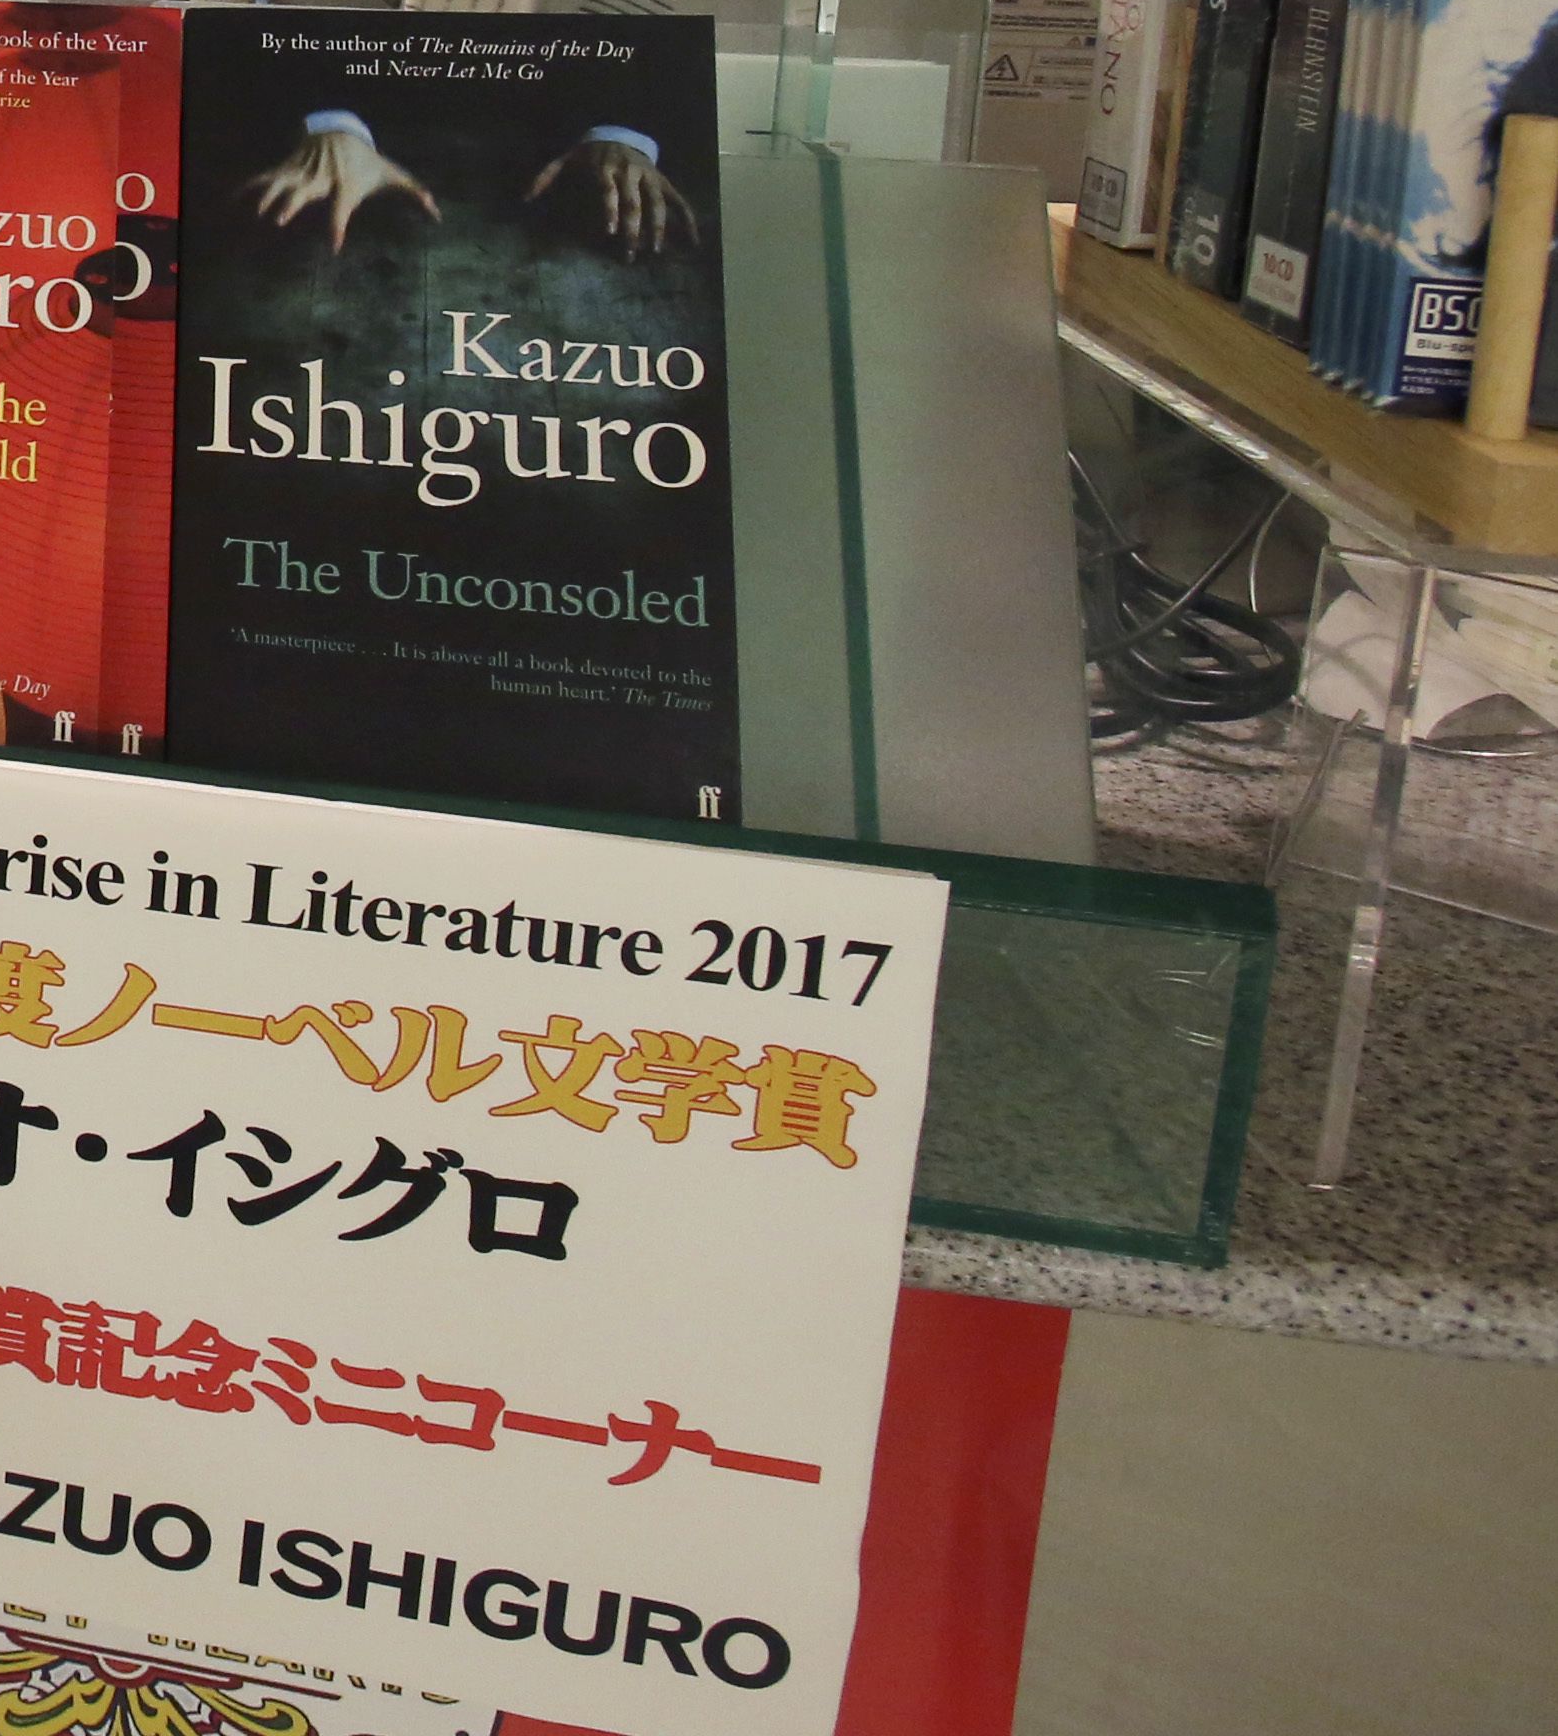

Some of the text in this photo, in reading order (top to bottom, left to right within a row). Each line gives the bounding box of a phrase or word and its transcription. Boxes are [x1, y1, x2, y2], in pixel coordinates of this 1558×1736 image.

[38, 30, 63, 51] of
[65, 32, 98, 53] the
[103, 33, 150, 54] Year
[261, 32, 635, 64] By the author of The Remains of the Day
[345, 60, 545, 82] and Never Let Me Go
[1295, 8, 1331, 133] BERNSTEIN
[441, 309, 707, 392] Kazuo
[196, 355, 708, 509] Ishiguro
[221, 536, 711, 628] The Unconsoled
[146, 851, 221, 920] in
[243, 864, 666, 977] Literature
[687, 920, 894, 1009] 2017
[240, 1518, 792, 1693] ISHIGURO
